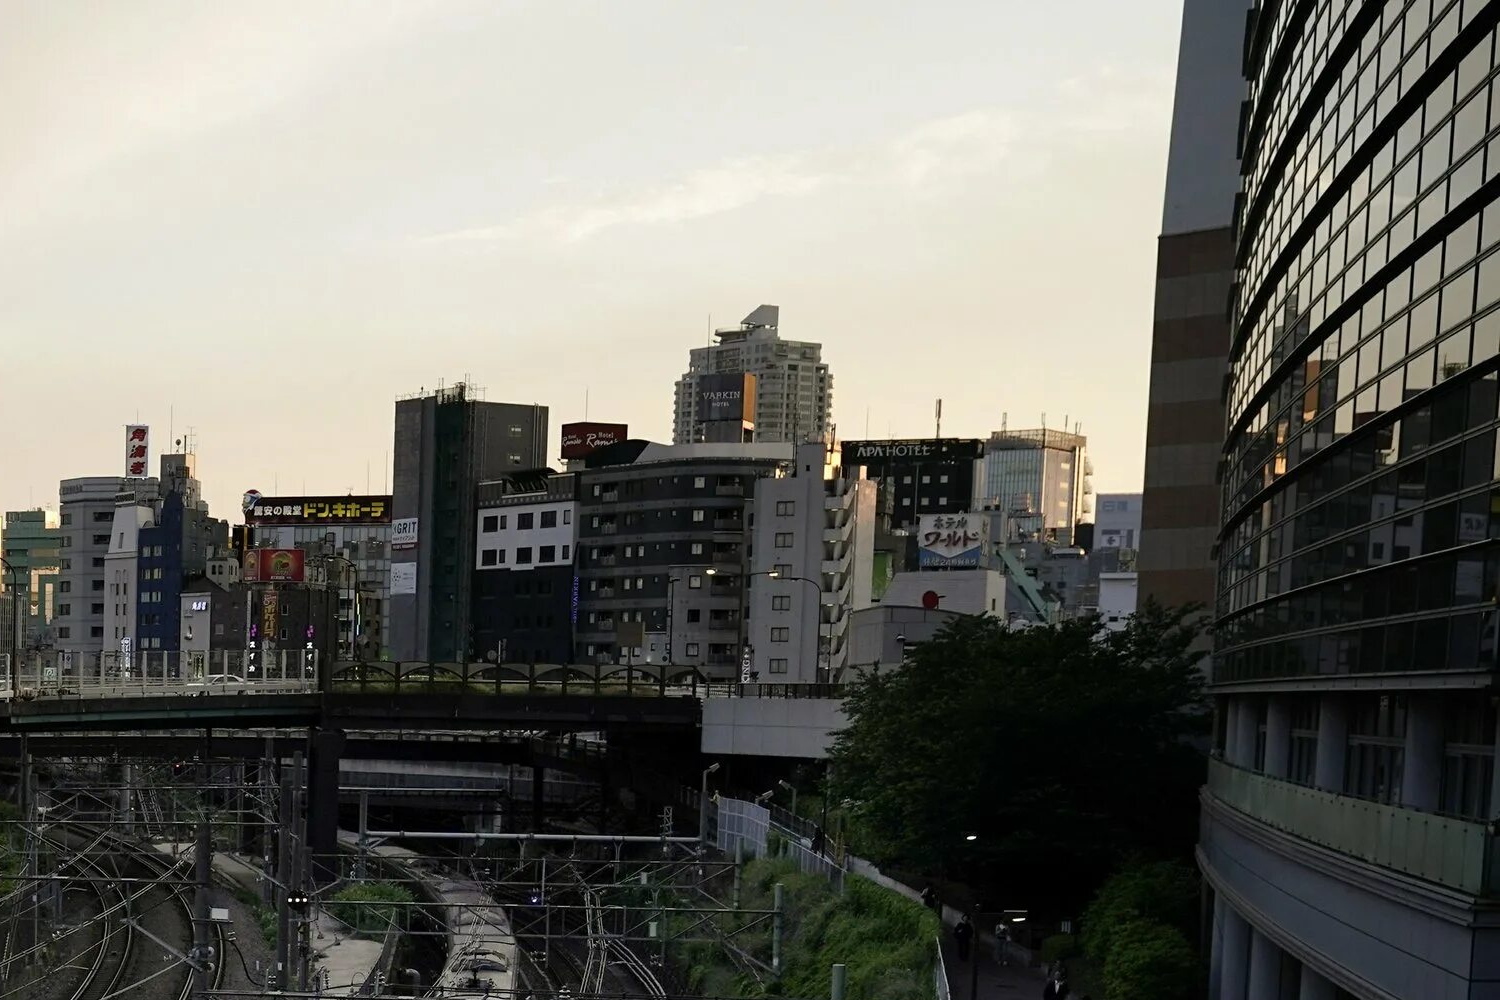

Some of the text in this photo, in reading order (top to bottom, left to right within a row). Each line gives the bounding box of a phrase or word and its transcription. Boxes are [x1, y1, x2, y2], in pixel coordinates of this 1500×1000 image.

[703, 391, 740, 400] VARKIN
[129, 428, 147, 475] 角海老
[857, 445, 930, 457] APA HOTEL
[254, 505, 302, 516] 驚安の殿堂
[397, 521, 416, 534] GRIT
[933, 516, 968, 530] ホテル
[924, 530, 979, 548] ワールド
